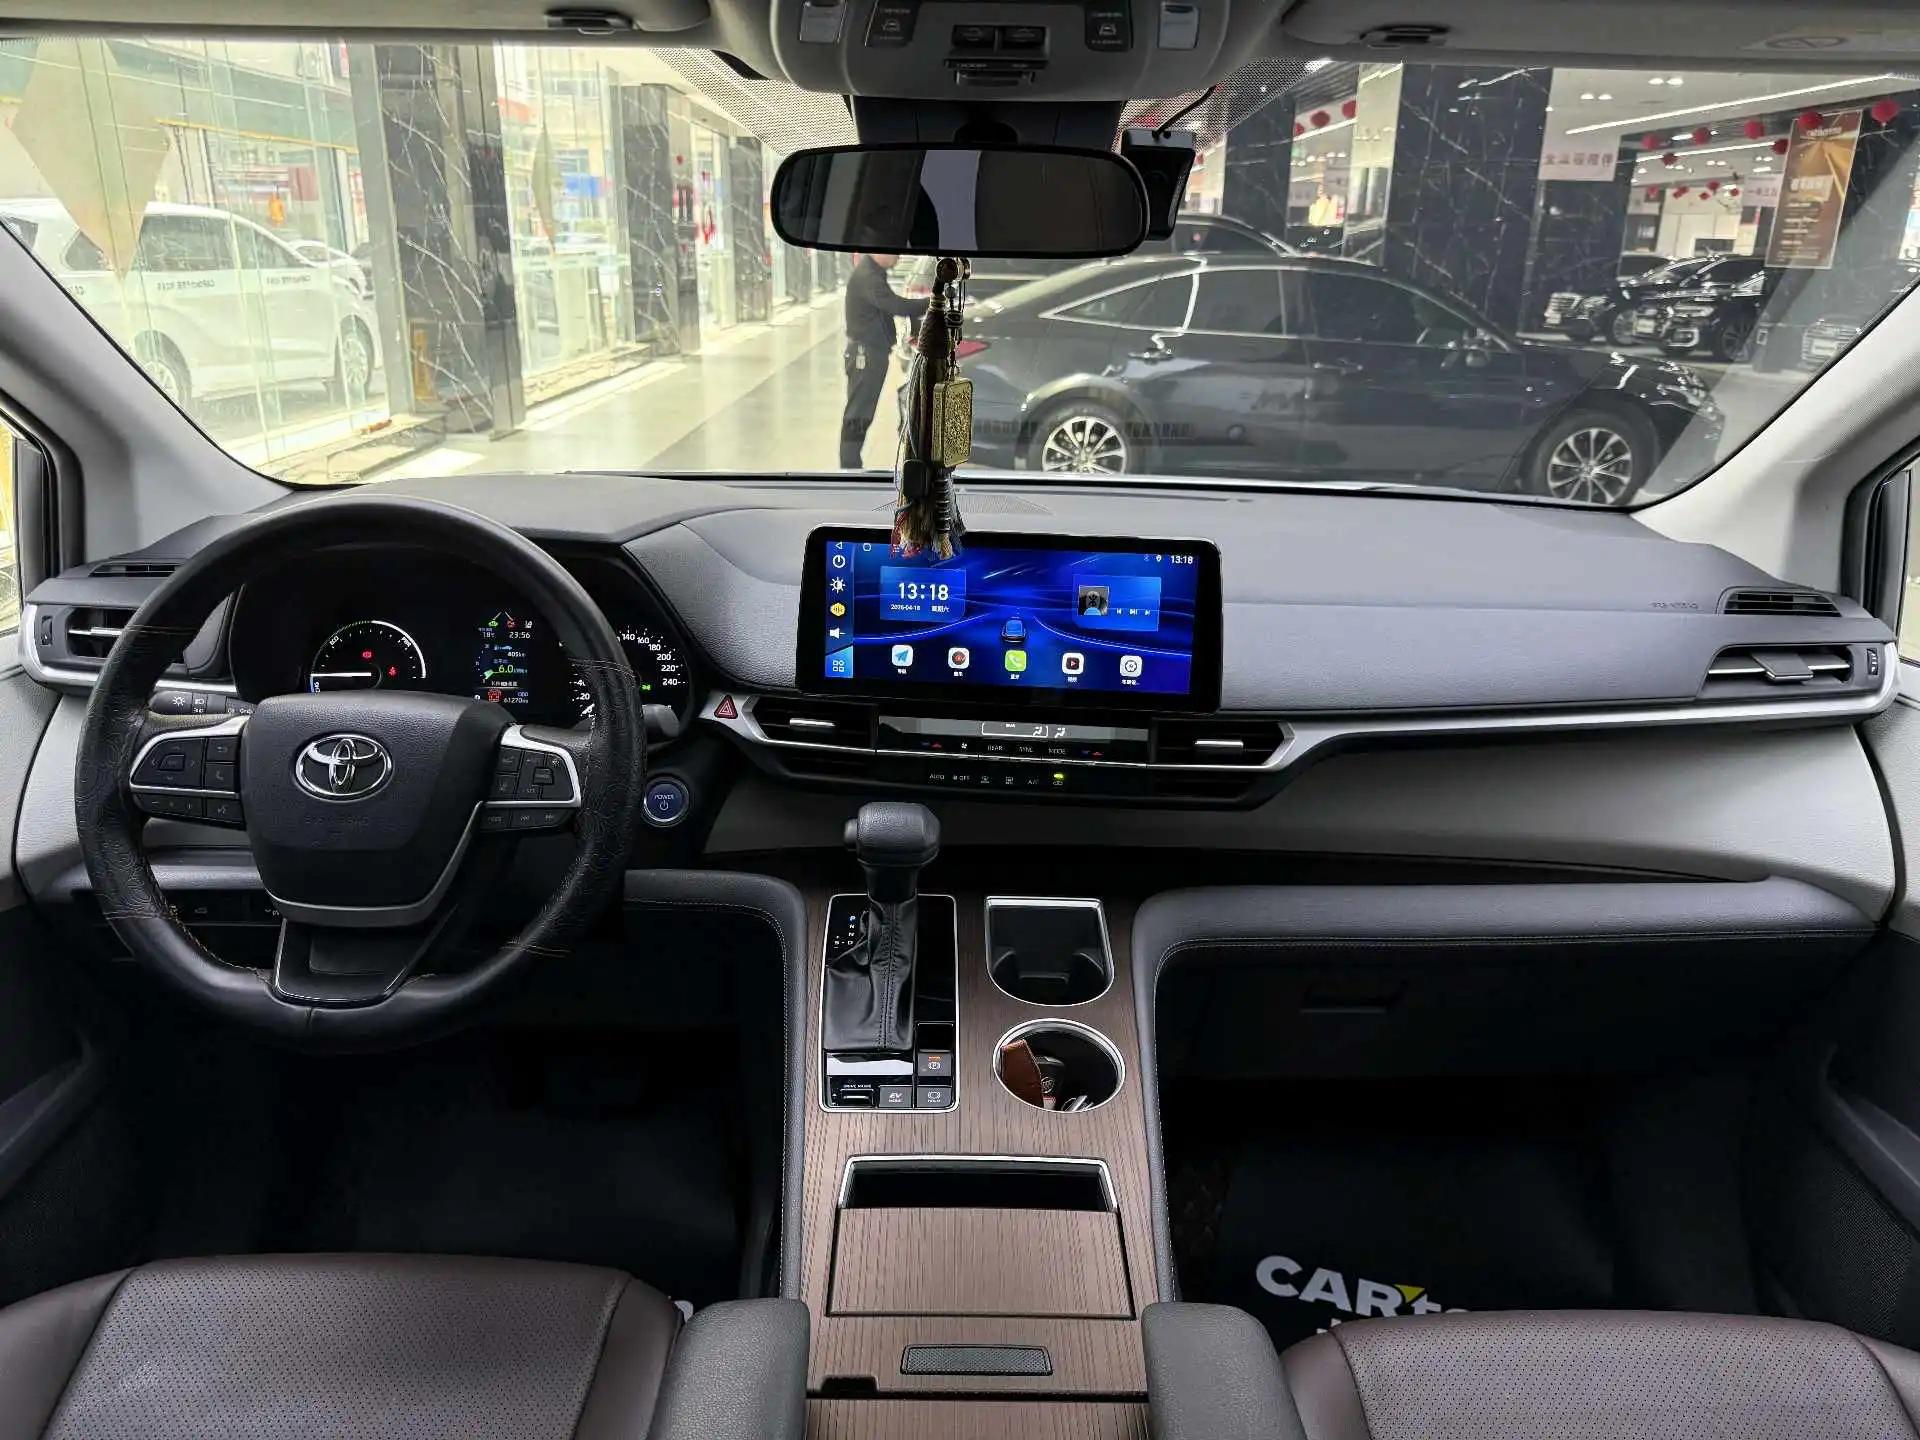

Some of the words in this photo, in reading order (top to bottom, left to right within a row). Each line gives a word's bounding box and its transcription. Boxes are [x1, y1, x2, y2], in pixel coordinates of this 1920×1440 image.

[1170, 555, 1193, 564] 13:18
[898, 582, 949, 601] 13:18
[509, 631, 531, 639] 23:56
[621, 633, 636, 641] 140
[637, 636, 650, 644] 160
[648, 643, 661, 651] 180
[656, 653, 672, 661] 200
[498, 664, 514, 673] 6.0
[660, 664, 676, 672] 220
[662, 678, 678, 686] 240
[580, 692, 591, 700] 20
